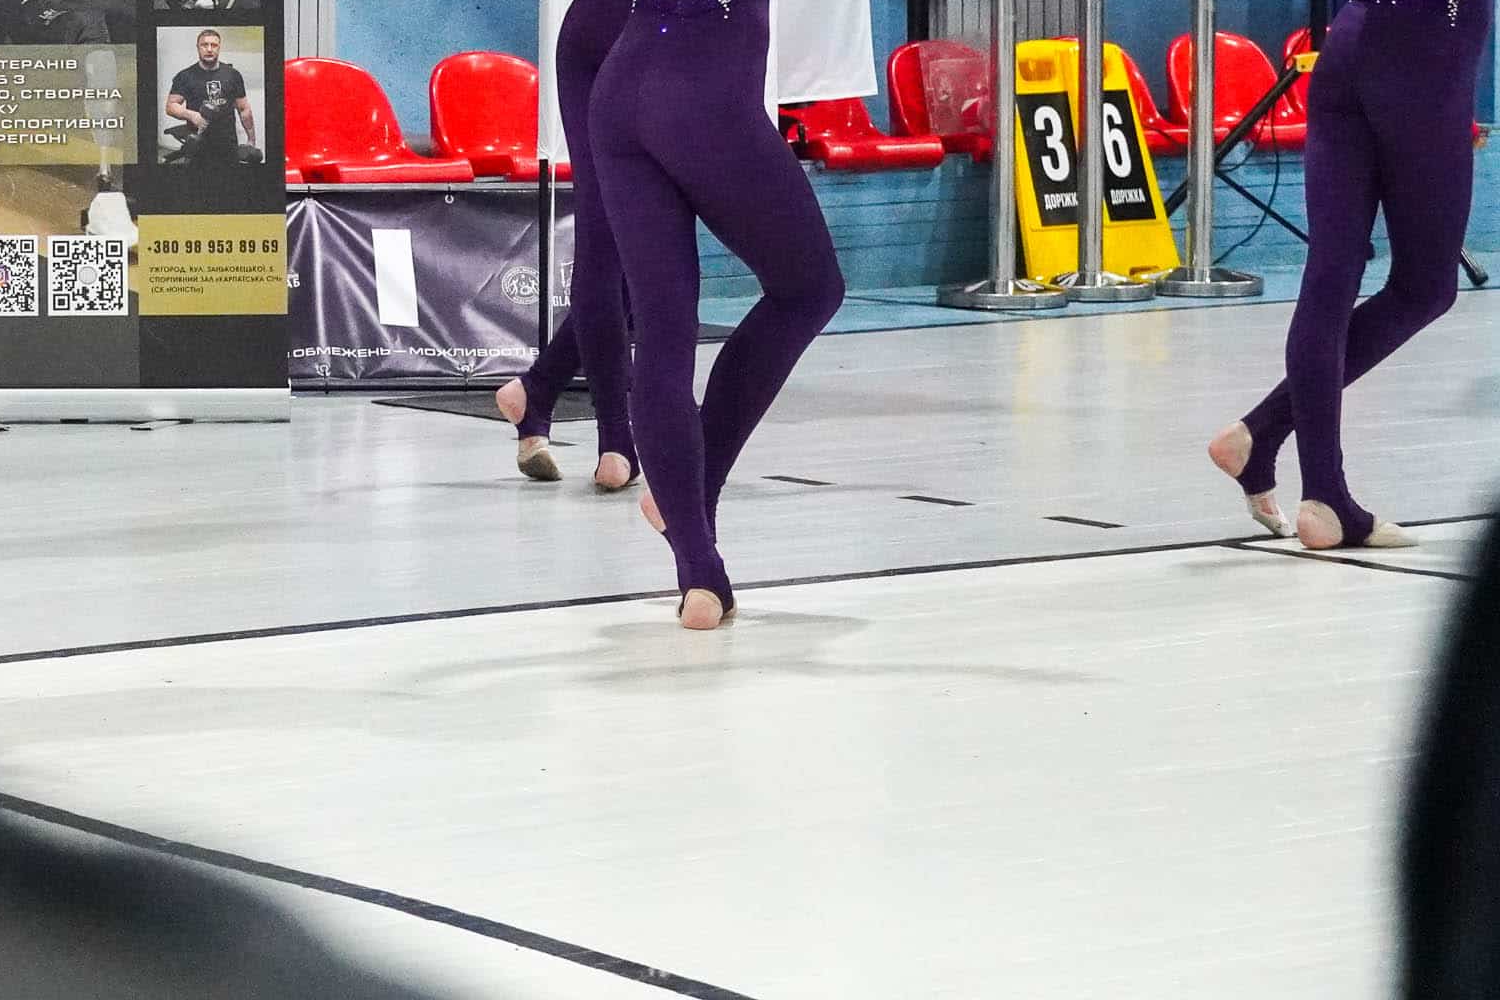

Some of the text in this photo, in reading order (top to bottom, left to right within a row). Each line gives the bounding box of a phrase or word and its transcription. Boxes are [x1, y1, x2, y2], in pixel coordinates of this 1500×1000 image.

[13, 74, 26, 85] З
[20, 88, 123, 100] СТВОРЕНА
[1, 117, 125, 130] СПОРТИВНОЇ
[1033, 105, 1071, 182] 3
[1102, 102, 1133, 178] 6
[1043, 191, 1079, 211] ДОРІЖК
[1110, 187, 1146, 206] ДОРІЖКА
[185, 240, 202, 254] 98
[208, 240, 234, 254] 953
[239, 240, 256, 254] 89
[262, 239, 279, 254] 69
[292, 345, 391, 358] ОБМЕЖЕНЬ
[409, 346, 526, 358] МОЖЛИВОСТІ
